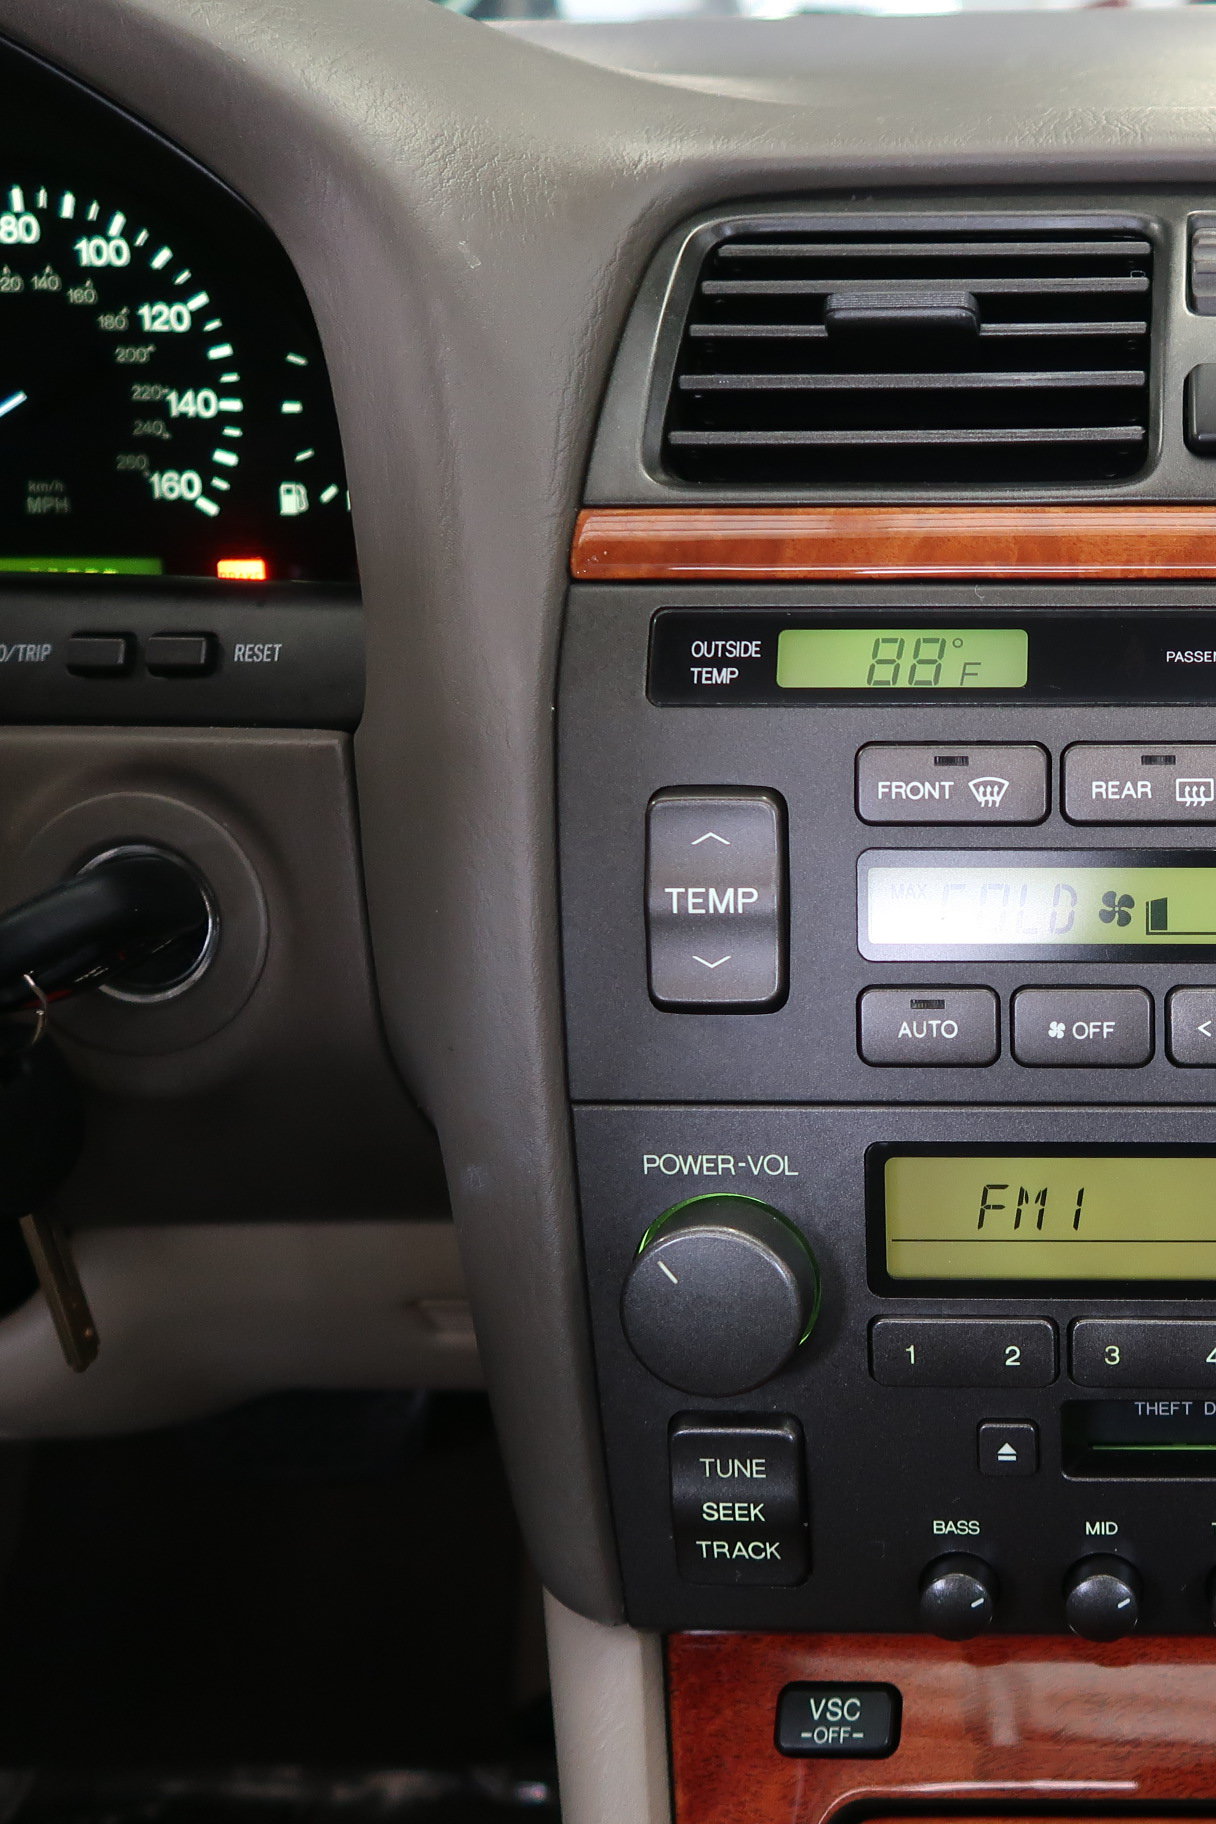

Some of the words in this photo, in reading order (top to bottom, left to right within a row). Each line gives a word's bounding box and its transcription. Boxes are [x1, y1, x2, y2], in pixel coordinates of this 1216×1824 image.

[0, 212, 40, 244] 80
[74, 236, 131, 267] 100
[31, 275, 61, 292] 140
[67, 287, 98, 304] 160
[97, 313, 127, 330] 180
[137, 303, 192, 333] 120
[115, 346, 149, 363] 200
[166, 388, 218, 418] 140
[150, 469, 203, 500] 160
[26, 496, 69, 514] MPH
[233, 642, 282, 664] RESET
[691, 640, 762, 658] OUTSIDE
[690, 667, 739, 685] TEMP
[877, 781, 955, 800] FRONT
[1091, 780, 1152, 800] REAR
[664, 887, 759, 914] TEMP
[897, 1019, 959, 1039] AUTO
[1072, 1021, 1116, 1040] OFF
[643, 1153, 799, 1176] POWER-VOL
[905, 1344, 915, 1365] 1
[1005, 1345, 1021, 1366] 2
[1104, 1345, 1120, 1366] 3
[1134, 1401, 1193, 1416] THEFT
[699, 1458, 767, 1479] TUNE
[702, 1501, 766, 1522] SEEK
[933, 1520, 980, 1535] BASS
[1085, 1521, 1119, 1536] MID
[695, 1540, 781, 1560] TRACK
[810, 1697, 861, 1722] VSC
